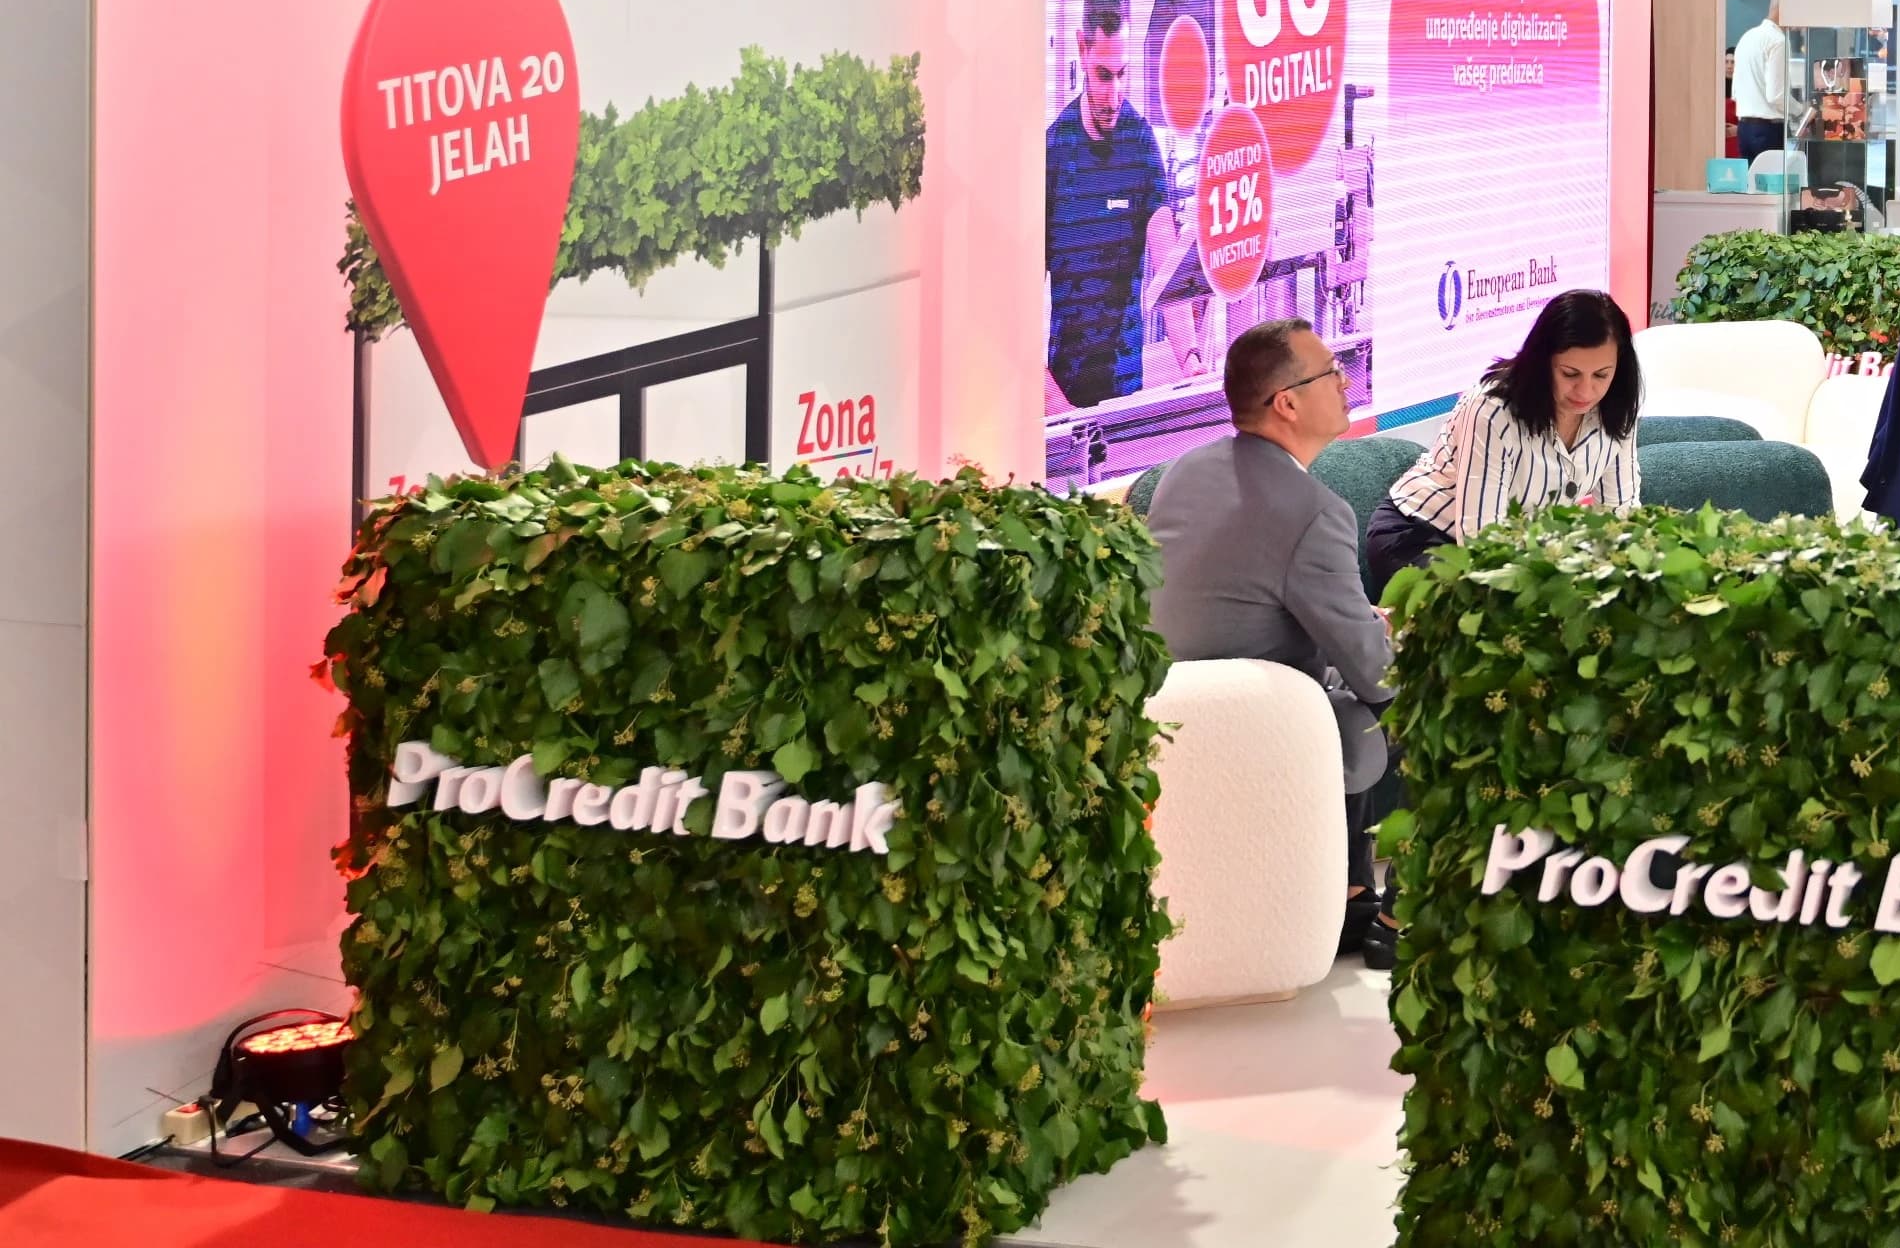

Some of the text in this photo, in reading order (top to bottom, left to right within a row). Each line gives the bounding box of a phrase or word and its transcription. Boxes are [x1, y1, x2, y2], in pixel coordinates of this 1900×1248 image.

[1425, 11, 1568, 47] unapređenje digitalizacije
[377, 51, 565, 130] TITOVA 20
[1244, 46, 1332, 109] DIGITAL!
[1453, 56, 1544, 93] vašeg preduzeća
[429, 114, 530, 195] JELAH
[1207, 143, 1261, 178] POVRAT DO
[1208, 172, 1263, 237] 15%
[1210, 234, 1261, 270] INVESTICIJE
[1467, 255, 1558, 302] European Bank
[797, 390, 875, 455] Zona
[387, 740, 902, 854] ProCredit Bank
[1481, 823, 1863, 929] ProCredit
